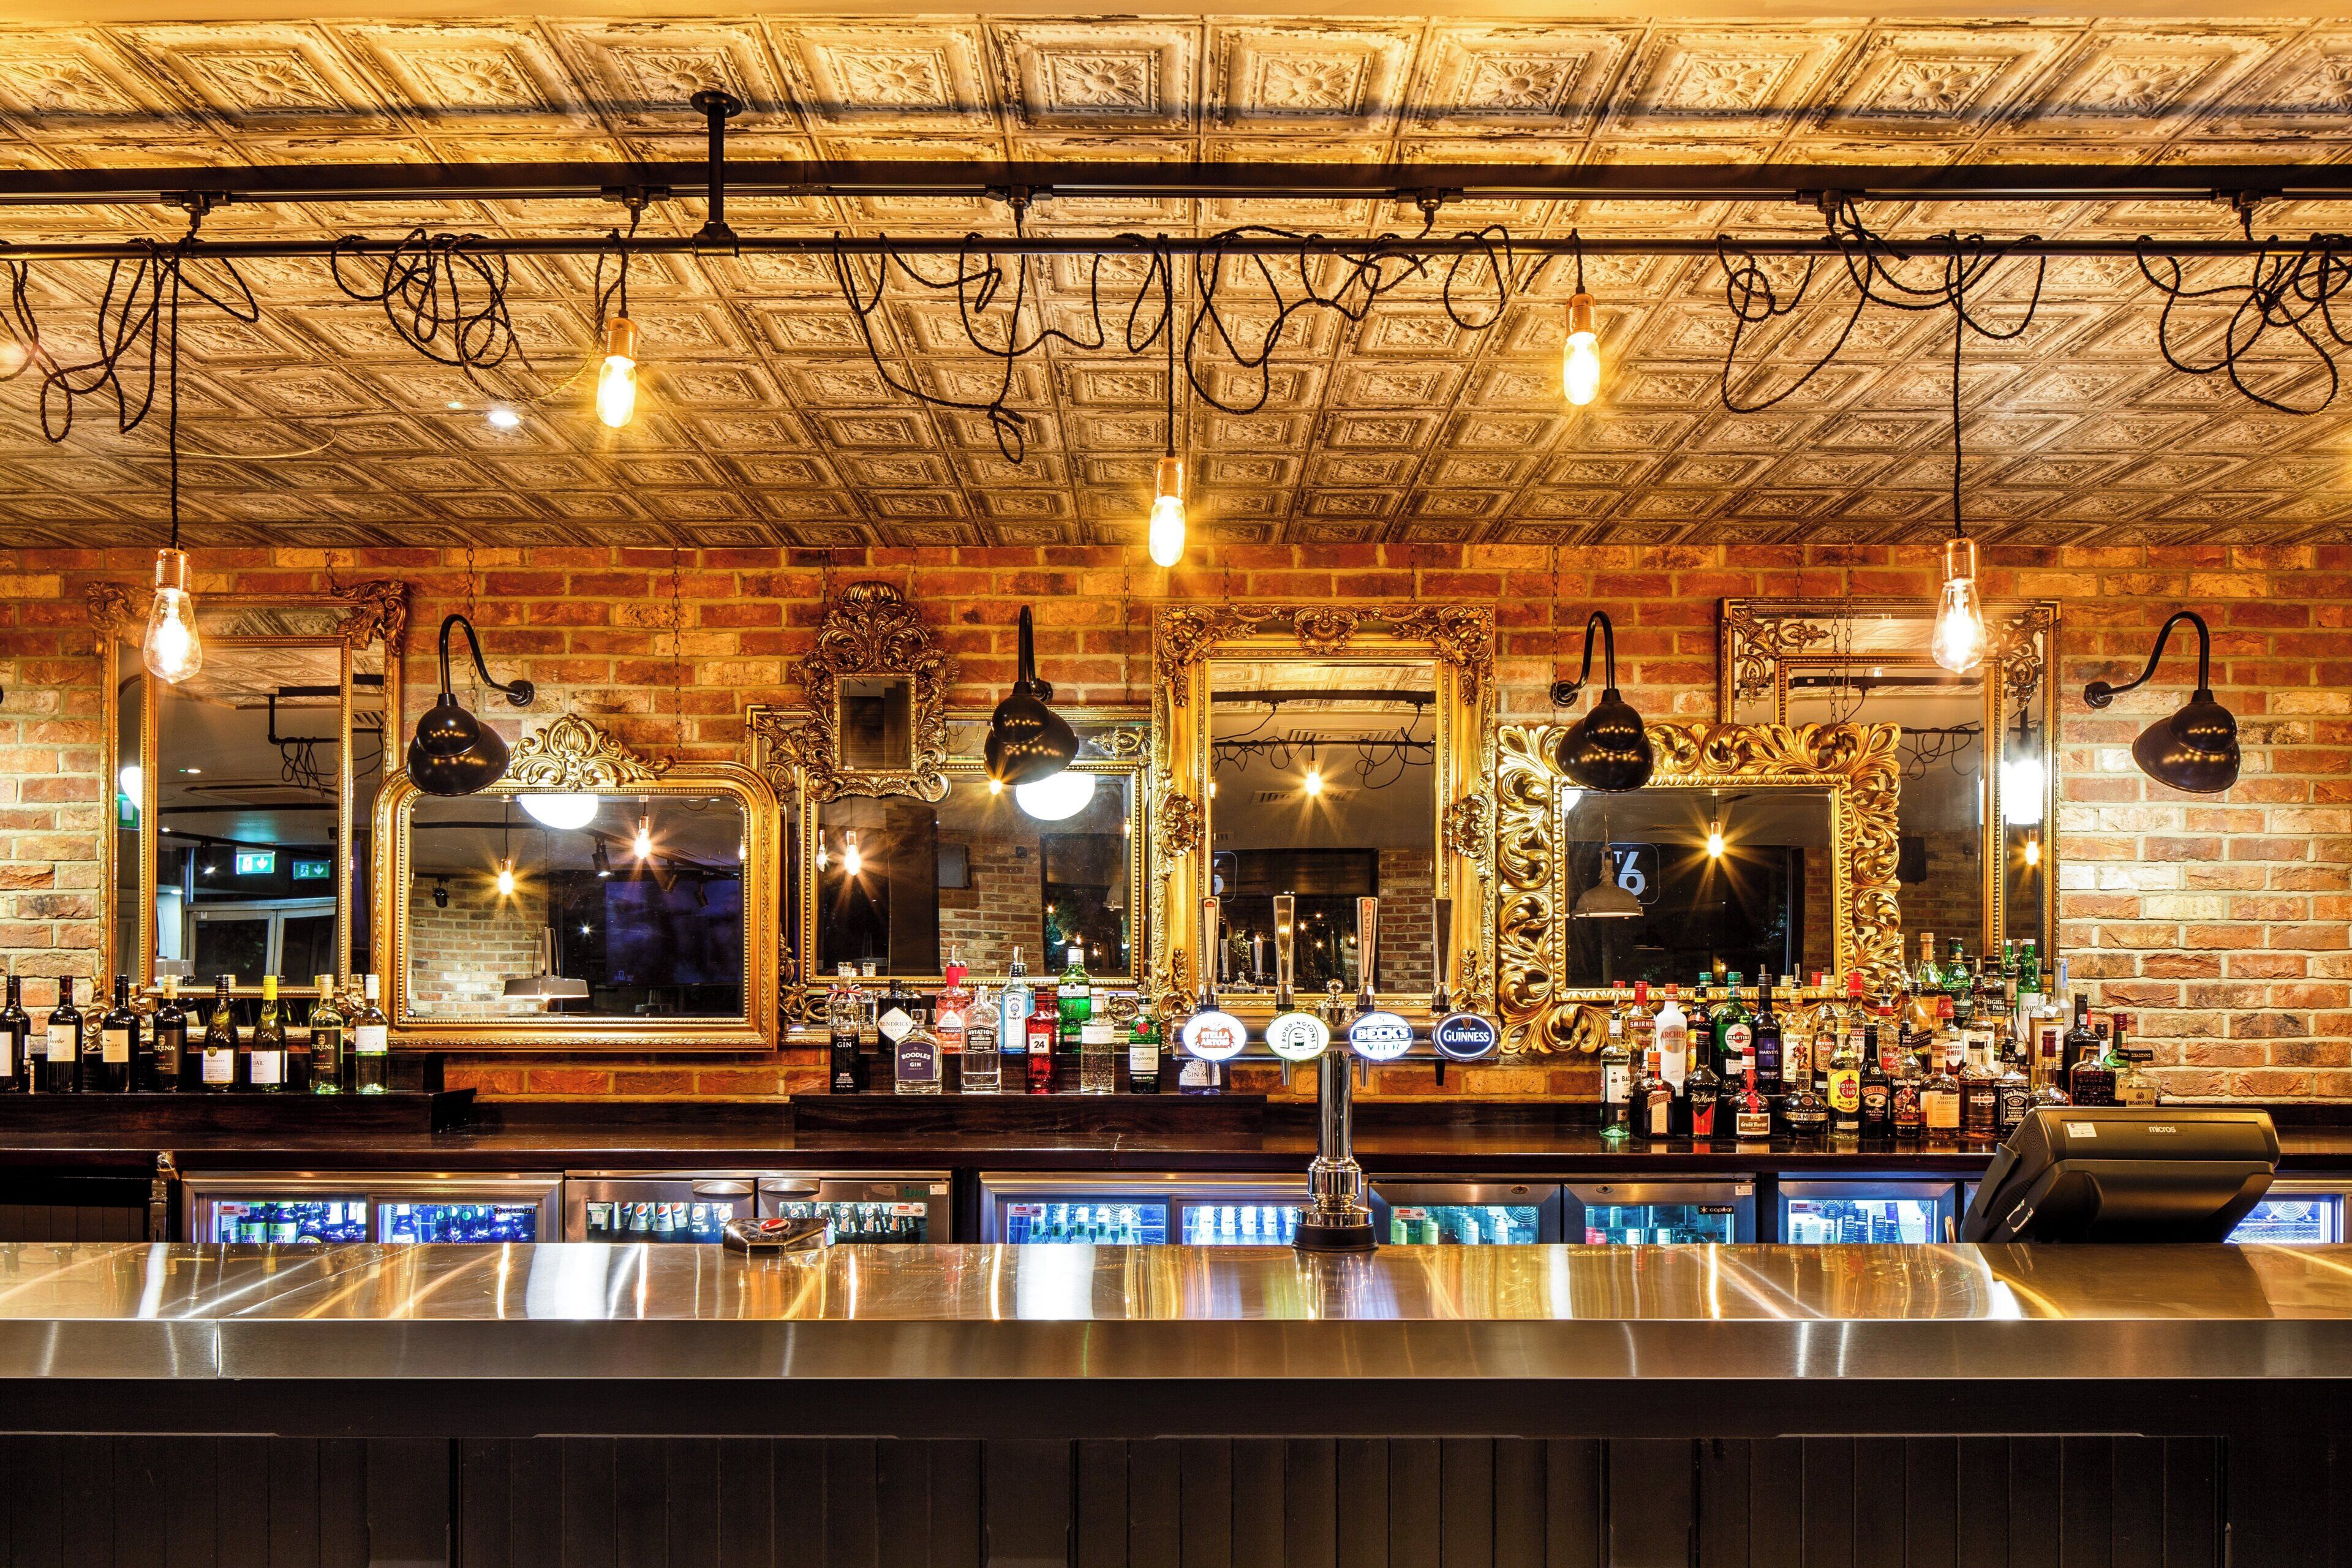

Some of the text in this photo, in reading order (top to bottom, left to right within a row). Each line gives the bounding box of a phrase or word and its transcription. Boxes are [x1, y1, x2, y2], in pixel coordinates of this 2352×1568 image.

[1355, 1027, 1409, 1040] BECK'S
[1443, 1030, 1490, 1042] GUINNESS
[901, 1052, 932, 1060] BOODLES
[1689, 1093, 1717, 1102] Tia Maria
[2003, 1091, 2013, 1101] JACK
[2149, 1124, 2176, 1133] micros
